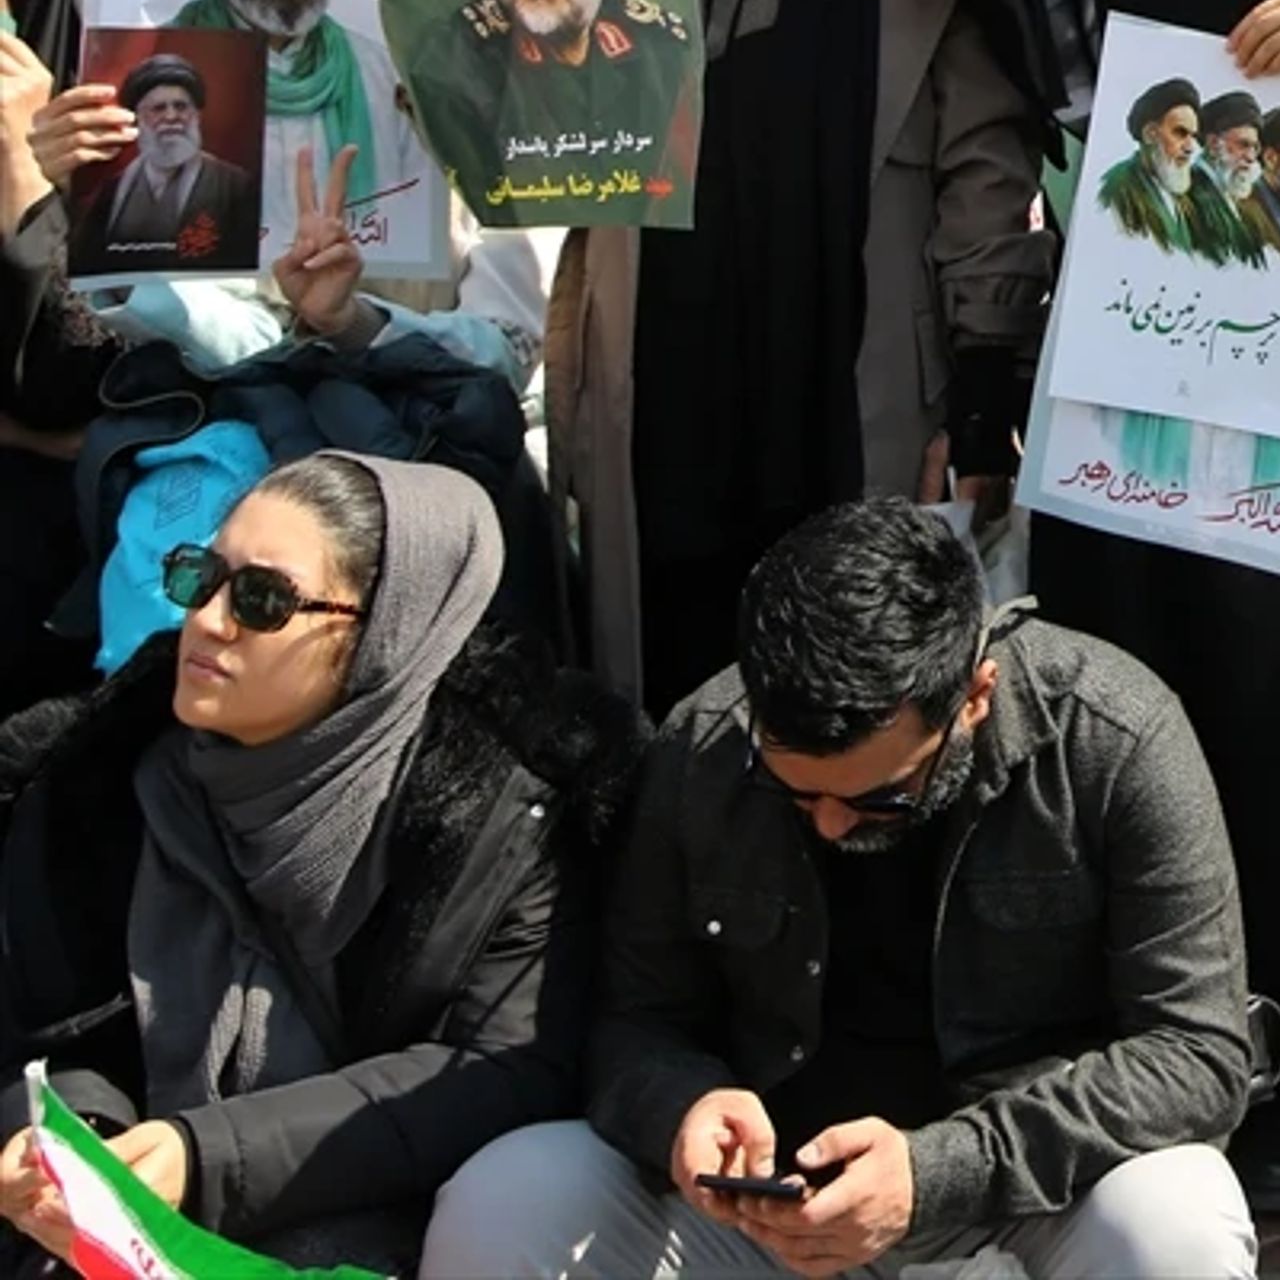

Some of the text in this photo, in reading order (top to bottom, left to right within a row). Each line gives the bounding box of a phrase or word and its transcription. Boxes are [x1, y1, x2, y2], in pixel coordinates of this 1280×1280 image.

[505, 136, 548, 161] پاسدار
[612, 129, 654, 154] سردار
[485, 174, 566, 205] سلیمانی
[567, 168, 642, 204] غلامرضا
[1153, 290, 1202, 347] زمین
[1194, 318, 1214, 348] بر
[1058, 459, 1112, 494] رهبر
